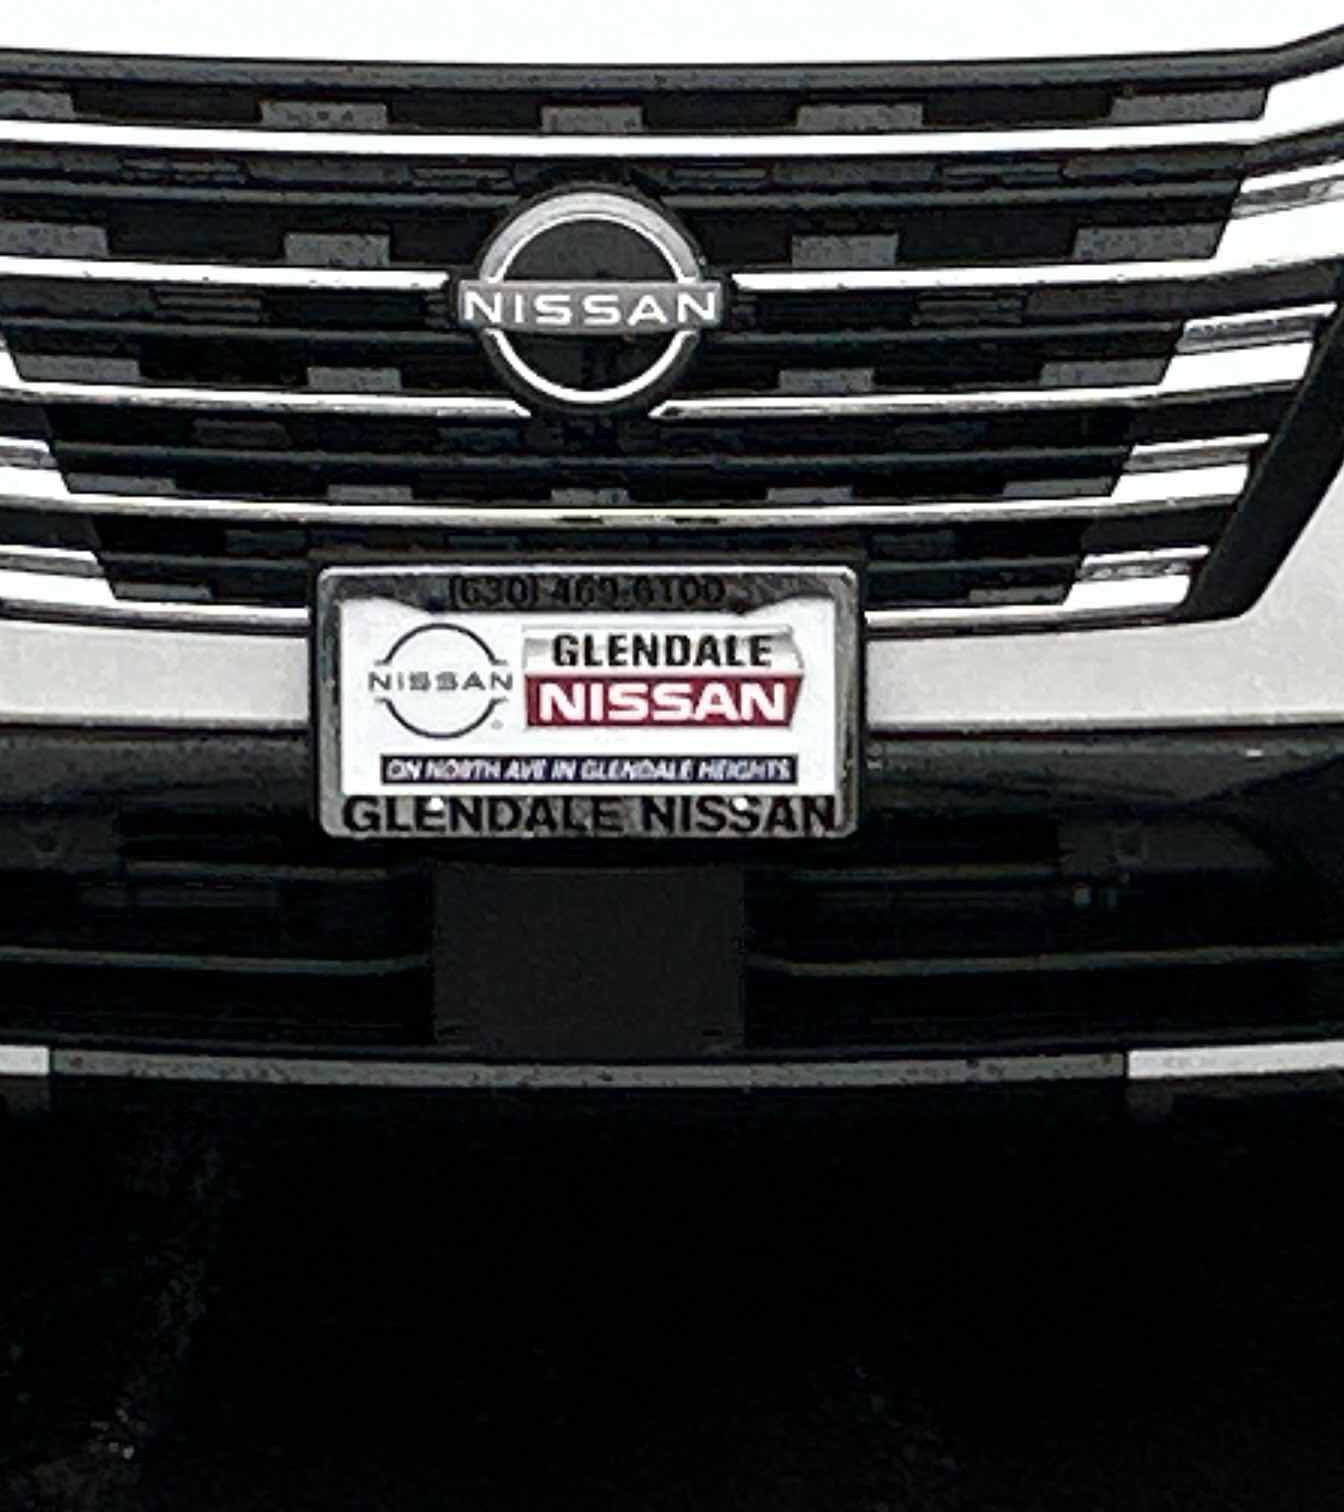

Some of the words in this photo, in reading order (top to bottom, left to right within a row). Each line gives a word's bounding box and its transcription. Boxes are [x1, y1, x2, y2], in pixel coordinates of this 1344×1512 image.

[463, 291, 716, 327] NISSAN
[552, 634, 774, 668] GLENDALE
[367, 670, 514, 692] NISSAN
[538, 681, 787, 722] NISSAN
[387, 758, 423, 781] ON
[424, 758, 502, 781] NORTH
[503, 758, 547, 781] AVE
[550, 758, 577, 781] IN
[580, 758, 693, 781] GLENDALE
[697, 758, 791, 782] HEIGHTS
[341, 795, 624, 834] GLENDALE
[640, 794, 837, 833] NISSAN
